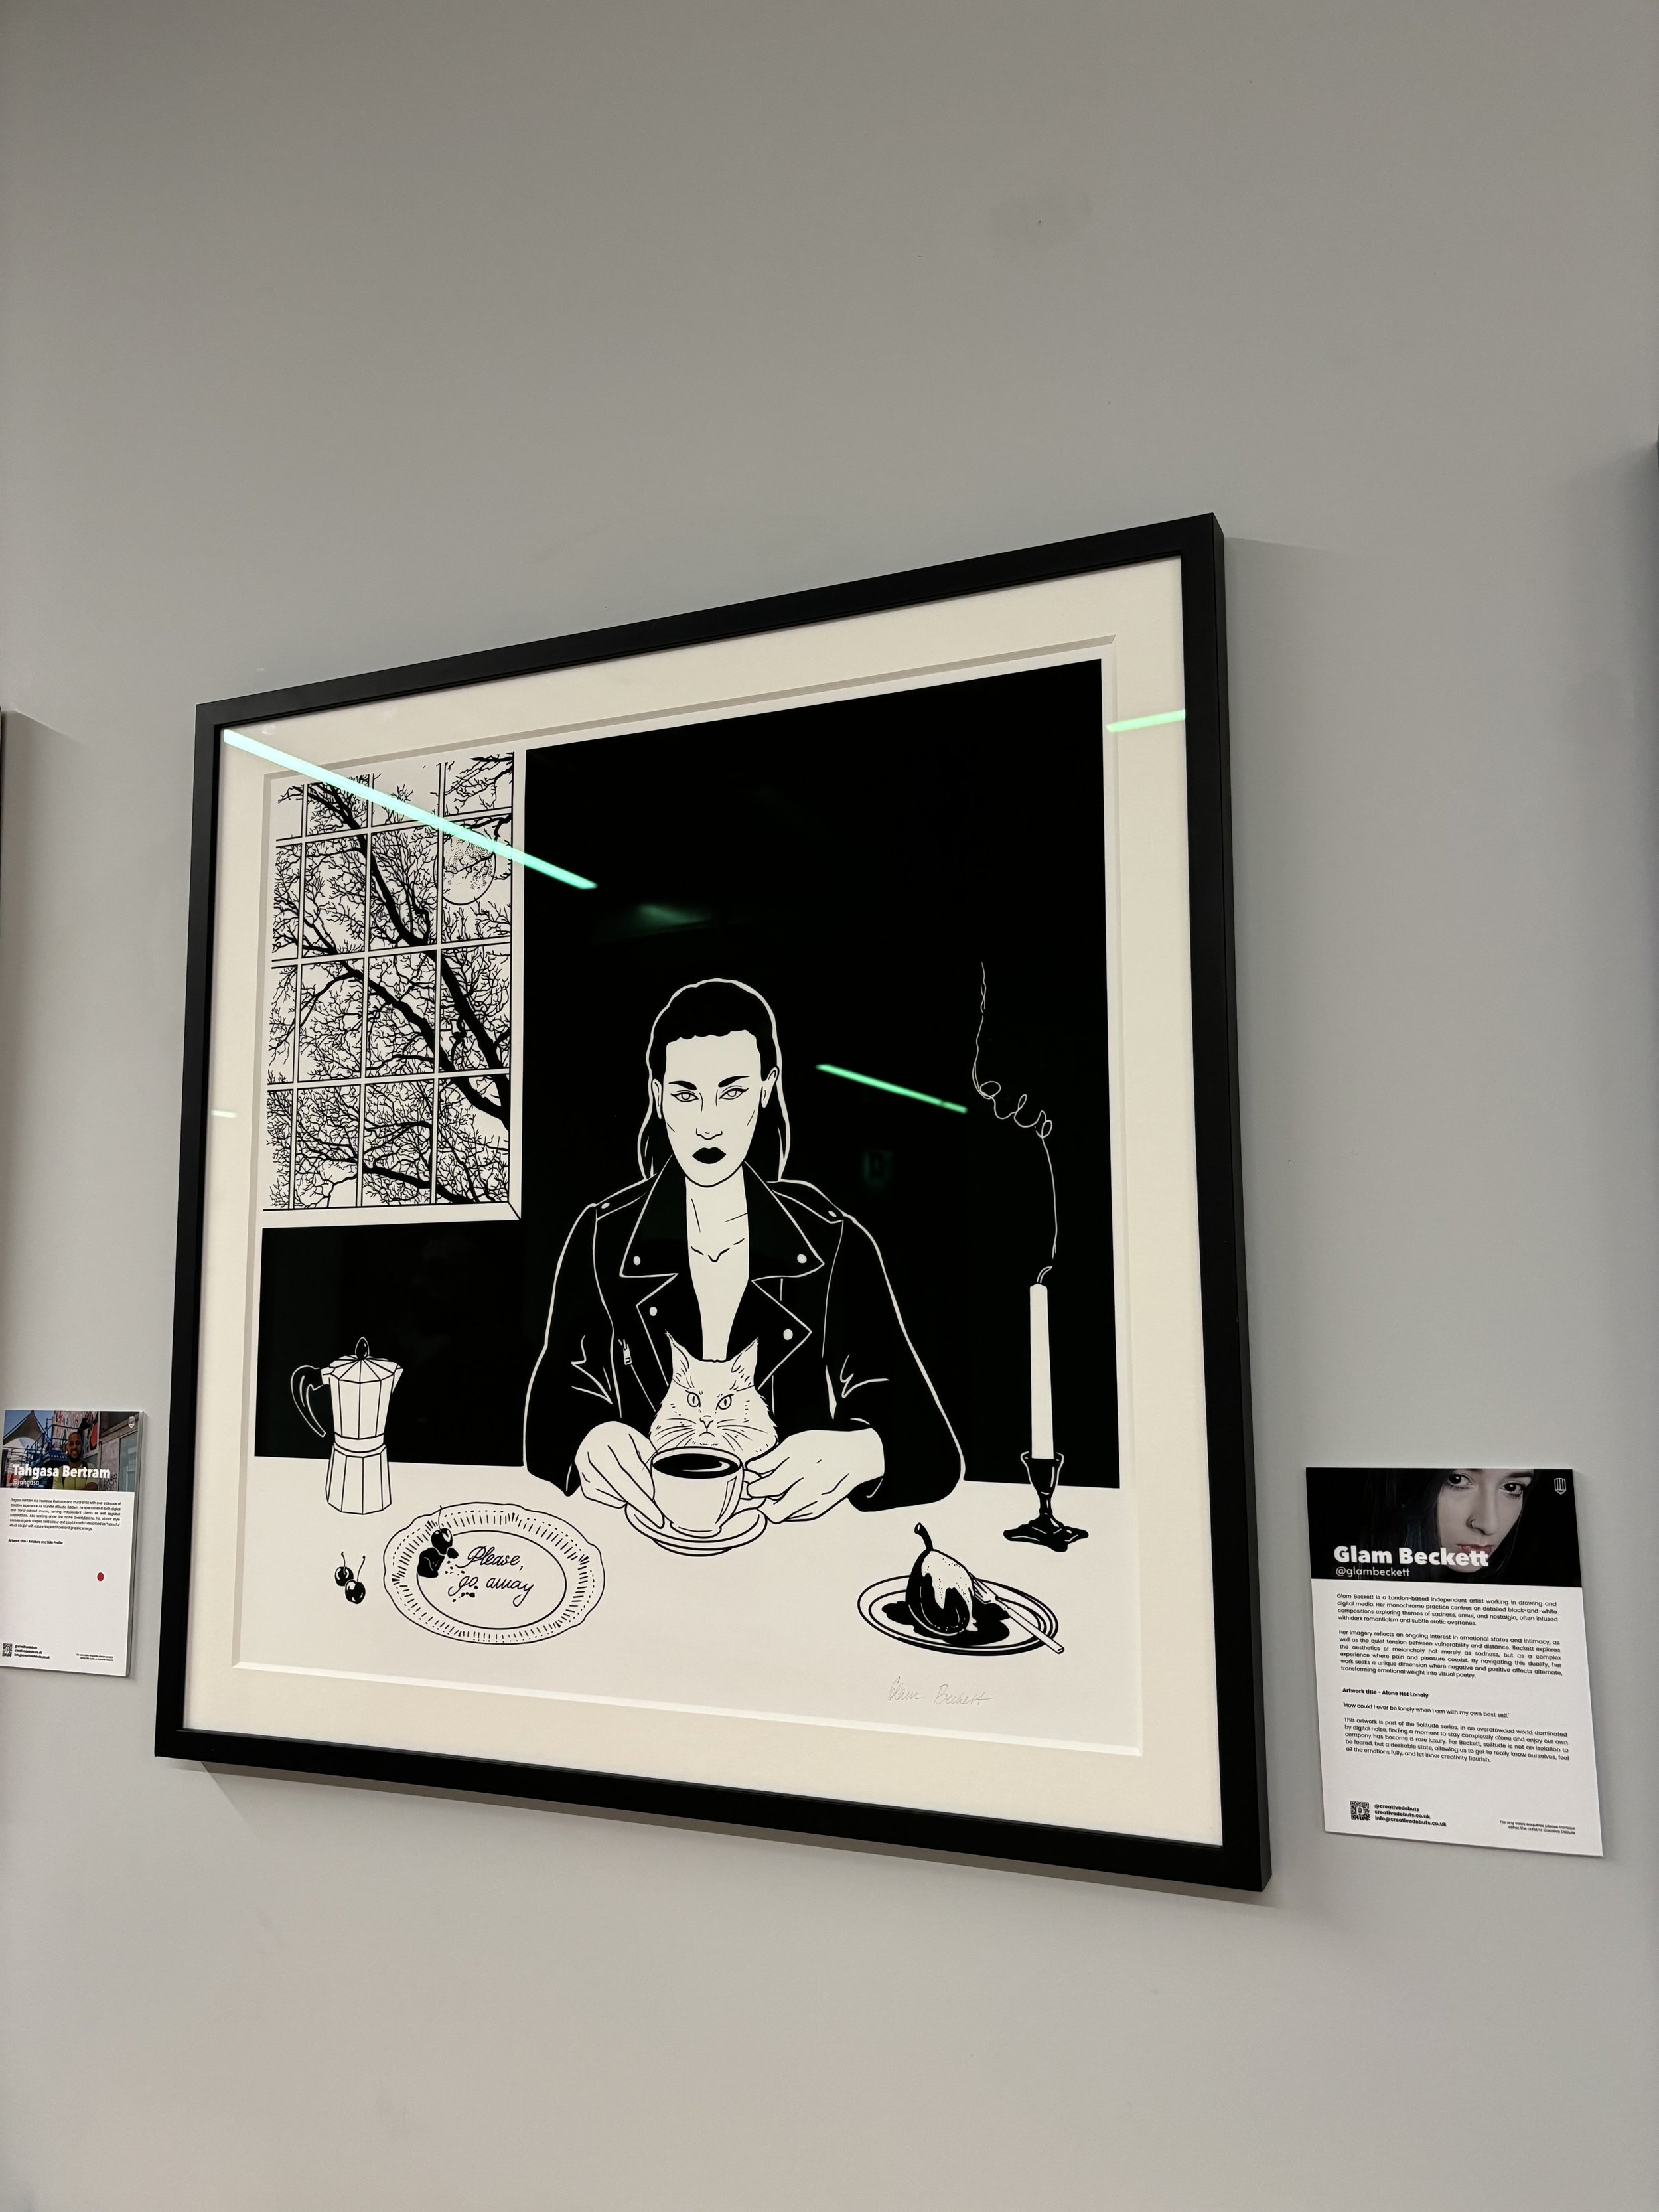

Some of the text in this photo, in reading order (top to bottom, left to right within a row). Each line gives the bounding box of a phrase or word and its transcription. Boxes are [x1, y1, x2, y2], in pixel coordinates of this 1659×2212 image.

[13, 1464, 110, 1479] Tahgasa Bertram
[455, 1546, 524, 1571] Please,
[1334, 1545, 1489, 1567] Glam Beckett
[1335, 1566, 1410, 1578] @glambeckett
[447, 1576, 535, 1608] go away
[1430, 1596, 1467, 1605] independent
[1485, 1598, 1509, 1607] working
[1518, 1599, 1543, 1608] drawing
[1337, 1607, 1374, 1615] compositions
[1434, 1641, 1469, 1649] vulnerability
[1535, 1645, 1561, 1654] explores
[1340, 1651, 1370, 1659] experience
[1419, 1655, 1445, 1663] pleasure
[1480, 1658, 1512, 1666] navigating
[1392, 1646, 1425, 1655] melancholy
[1535, 1653, 1561, 1662] complex
[1340, 1665, 1377, 1674] transforming
[1447, 1663, 1473, 1672] negative
[1487, 1665, 1511, 1674] positive
[1409, 1690, 1429, 1699] Lonely
[1374, 1803, 1420, 1812] @creativedebuts
[1374, 1808, 1431, 1819] creativedebuts.co.uk
[1374, 1814, 1447, 1827] info@creativedebuts.co.uk
